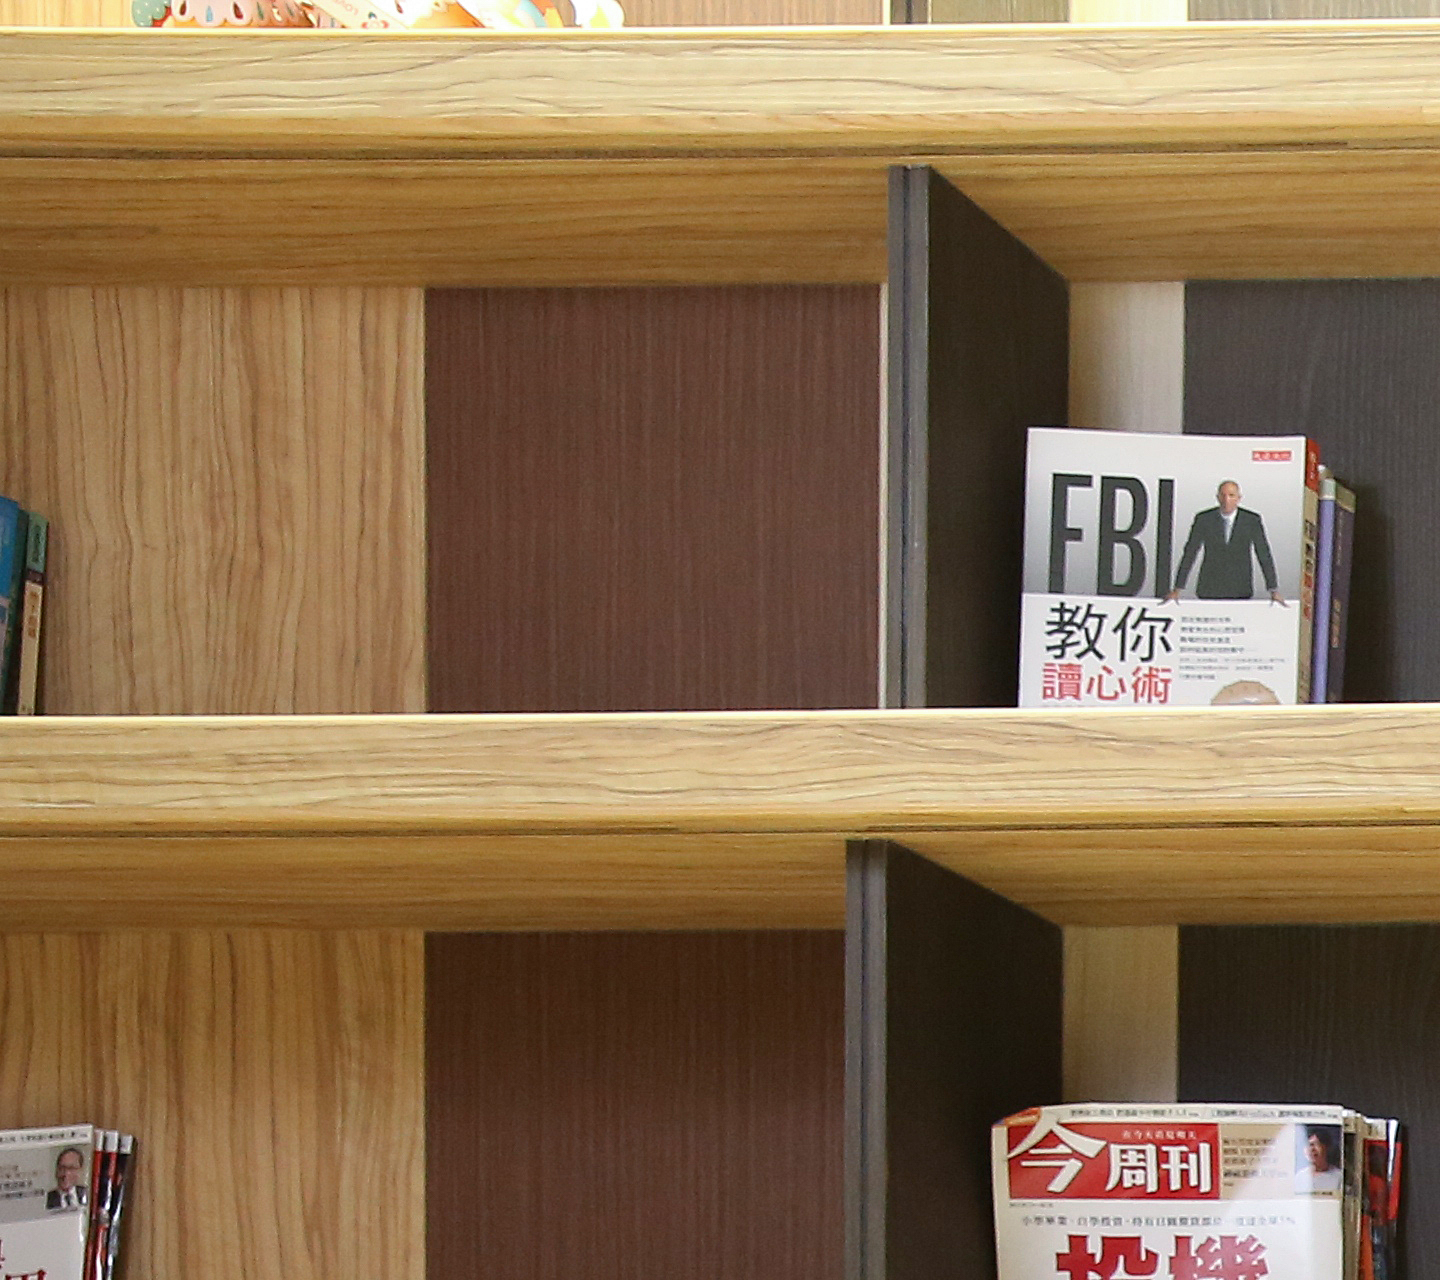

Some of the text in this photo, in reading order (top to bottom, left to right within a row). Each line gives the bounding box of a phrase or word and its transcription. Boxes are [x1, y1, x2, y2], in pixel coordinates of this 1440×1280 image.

[1047, 473, 1176, 598] FBI
[1044, 600, 1174, 663] 教你
[1041, 662, 1172, 703] 讀心術
[1007, 1110, 1212, 1195] 今周刊
